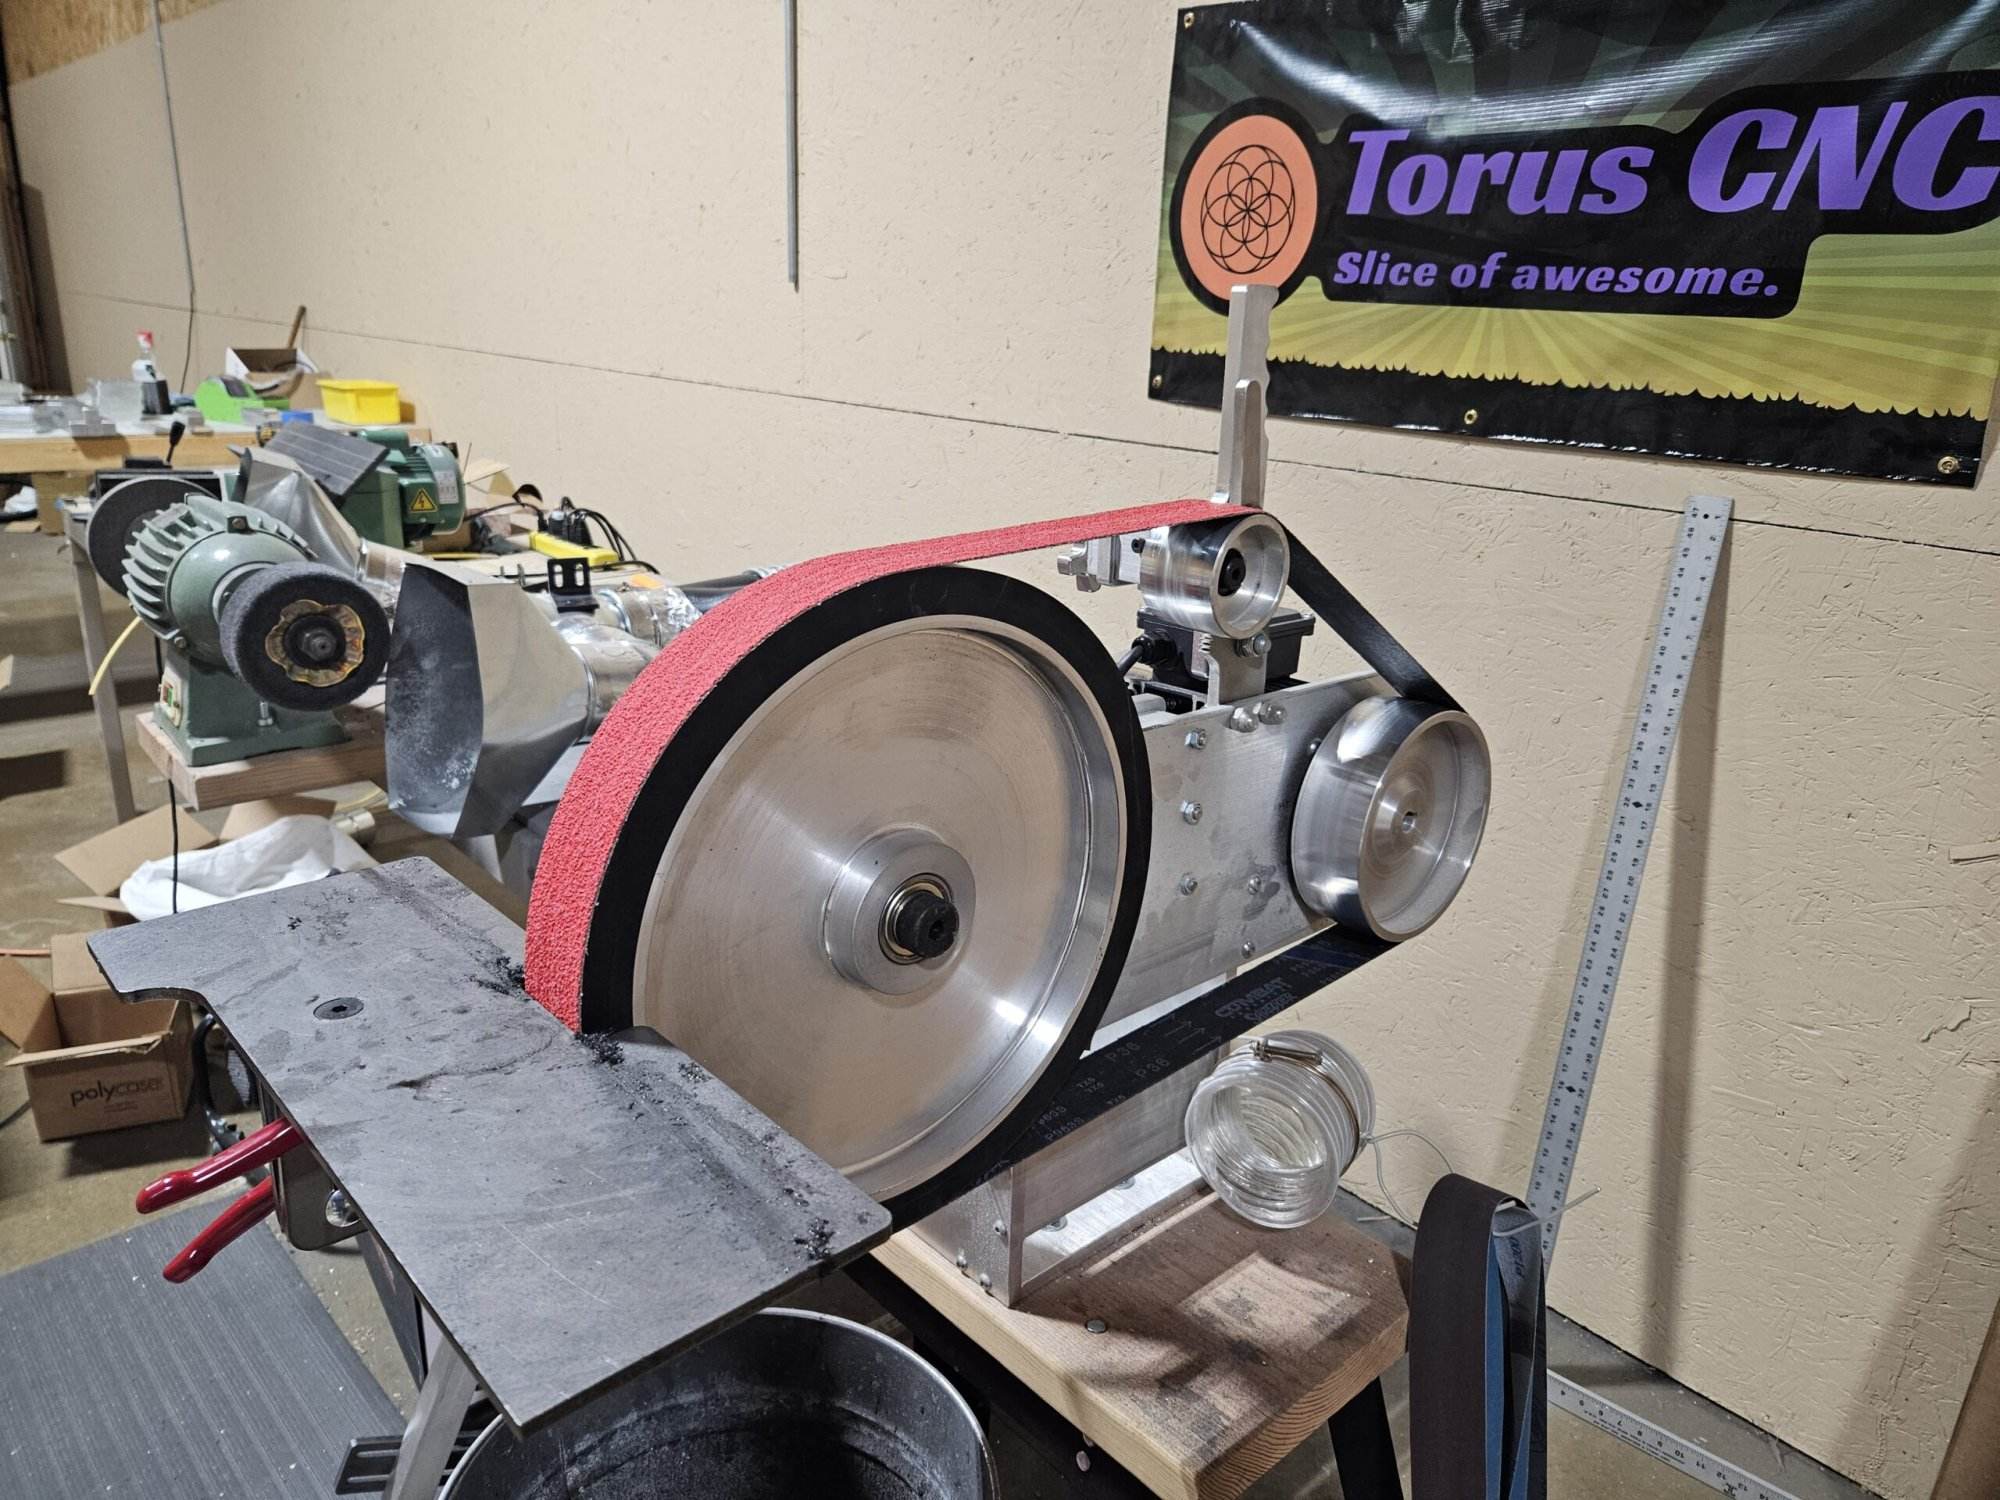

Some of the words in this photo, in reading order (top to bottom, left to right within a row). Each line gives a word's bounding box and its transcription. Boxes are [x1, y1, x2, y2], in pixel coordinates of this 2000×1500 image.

[1346, 129, 1655, 216] Torus
[1688, 95, 2000, 213] CNC
[1333, 251, 1438, 287] Slice
[1450, 252, 1508, 289] of
[1511, 264, 1779, 296] awesome.
